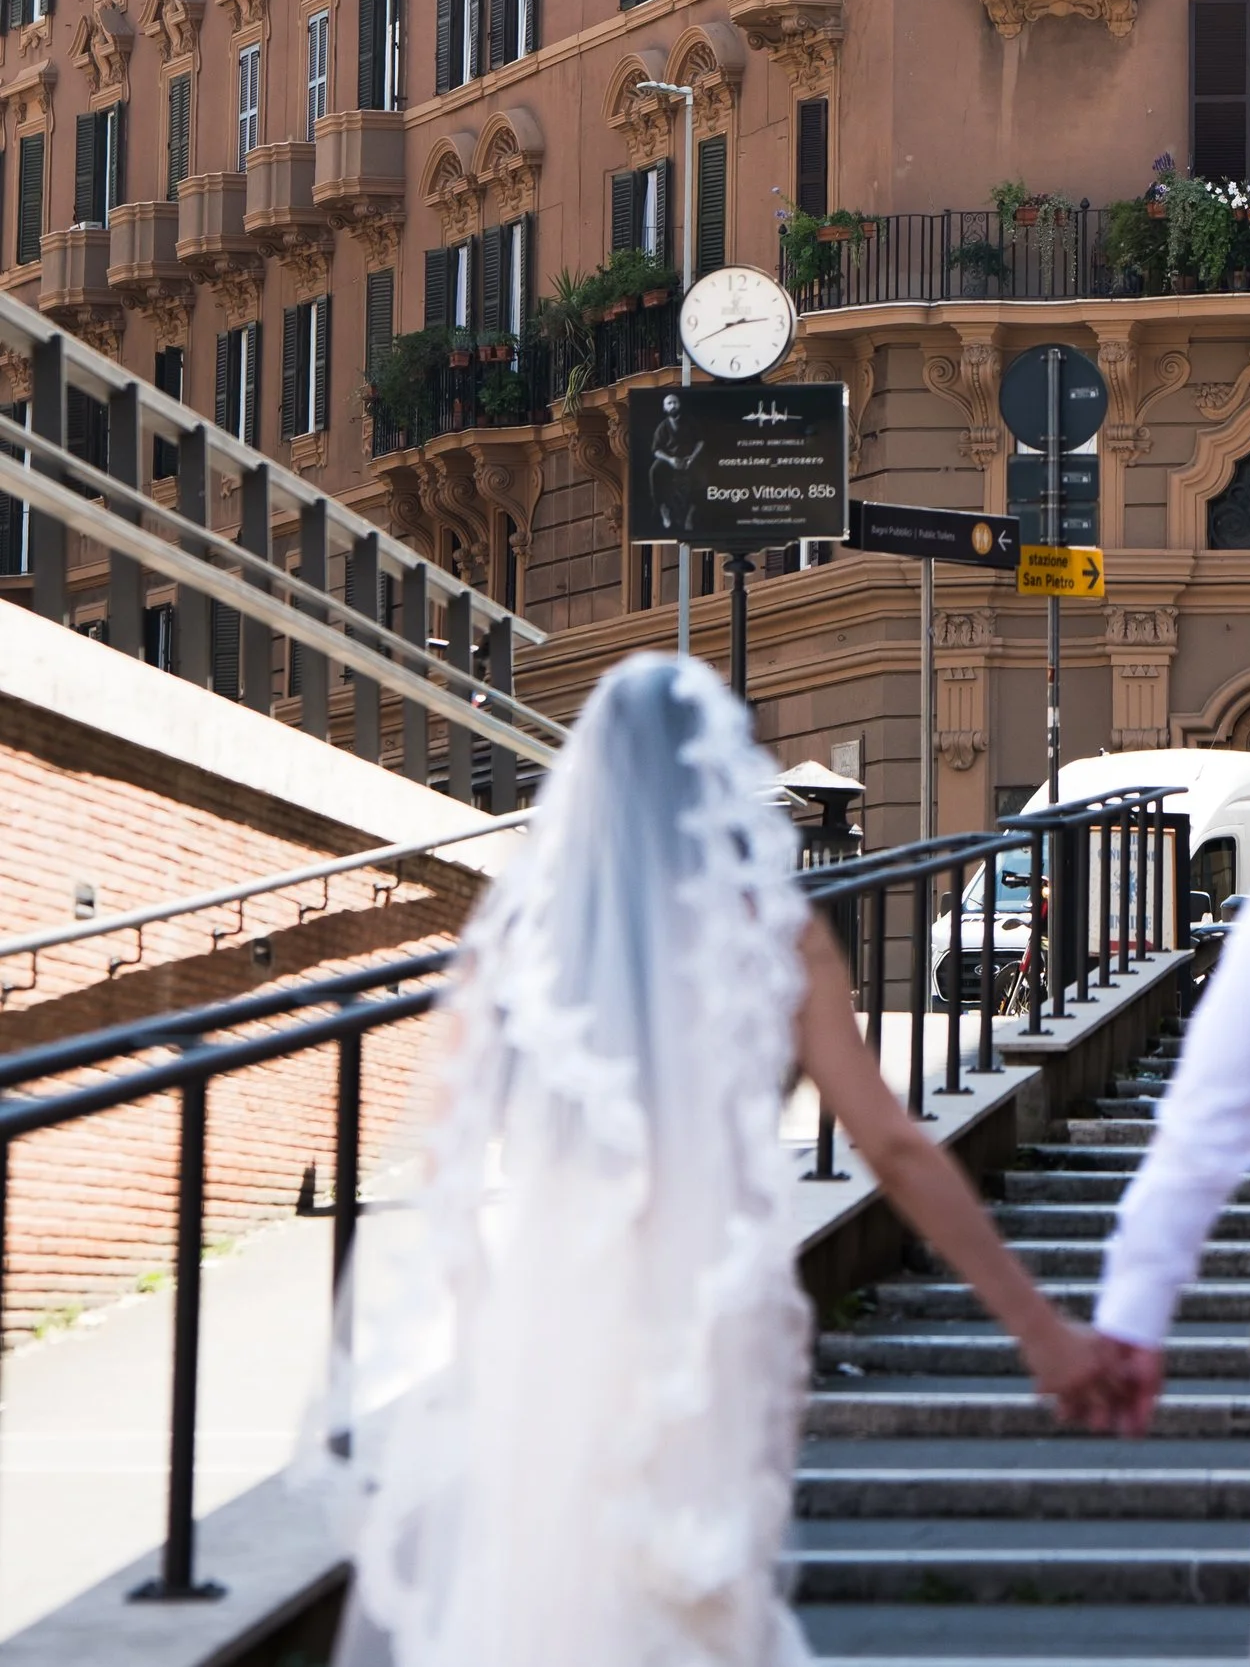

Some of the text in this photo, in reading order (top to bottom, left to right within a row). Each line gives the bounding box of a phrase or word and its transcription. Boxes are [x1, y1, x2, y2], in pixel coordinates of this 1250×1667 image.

[728, 274, 748, 292] 12
[687, 314, 699, 332] 9
[775, 314, 785, 332] 3
[729, 355, 741, 373] 6
[706, 483, 836, 503] Borgo Vittorio, 85b
[1028, 553, 1069, 568] stazione
[1022, 571, 1075, 590] San Pietro
